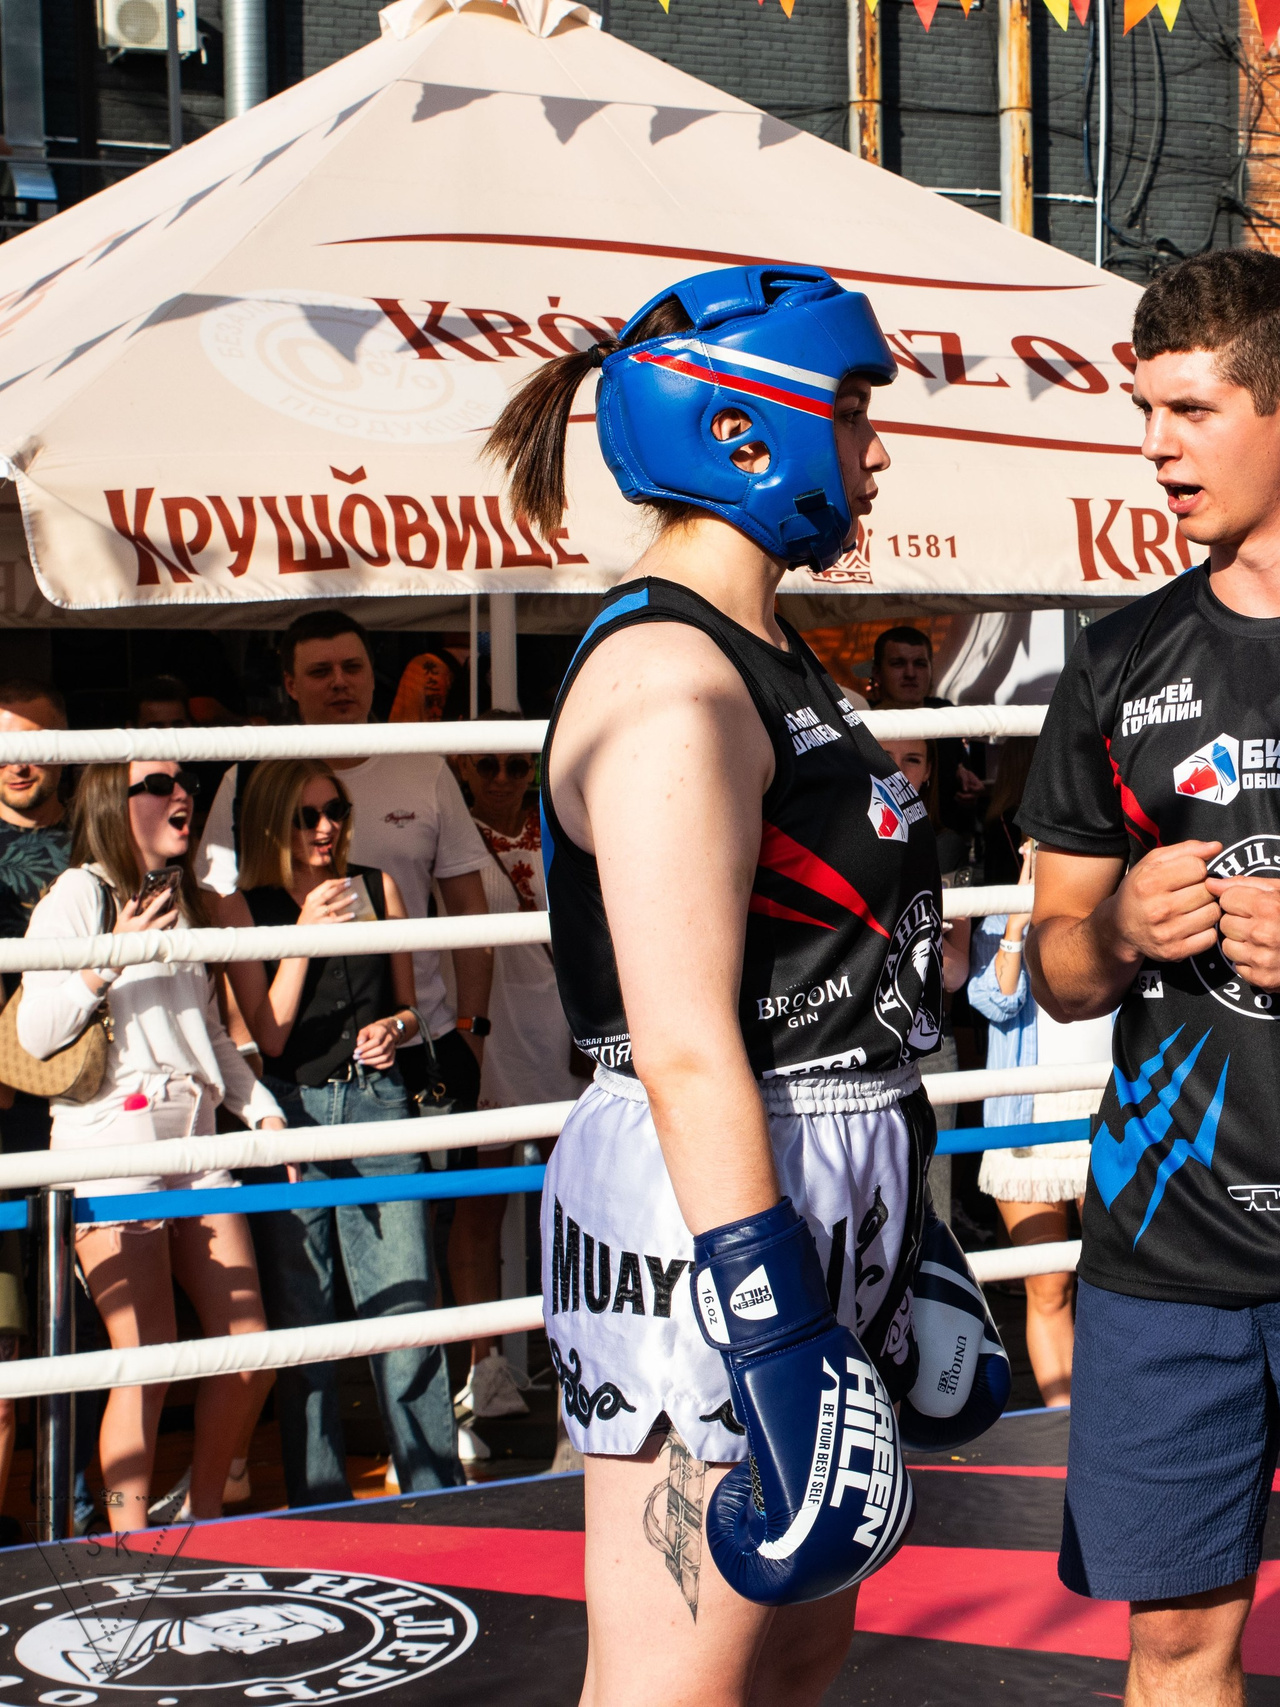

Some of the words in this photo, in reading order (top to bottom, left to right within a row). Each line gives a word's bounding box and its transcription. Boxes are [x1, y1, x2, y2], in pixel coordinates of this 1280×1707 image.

[888, 534, 957, 559] 1581
[757, 975, 853, 1021] BROOM
[788, 1011, 819, 1029] GIN
[552, 1193, 689, 1318] MUAY
[733, 1293, 773, 1312] GREEN
[736, 1285, 769, 1301] HILL
[946, 1335, 967, 1396] UNIQUE
[822, 1403, 834, 1418] BE
[819, 1421, 833, 1450] YOUR
[829, 1356, 876, 1508] HILL
[813, 1453, 829, 1480] BEST
[853, 1364, 895, 1548] GREEN
[807, 1481, 824, 1506] SELF
[101, 1572, 455, 1700] КАНЦЛЕРЪ
